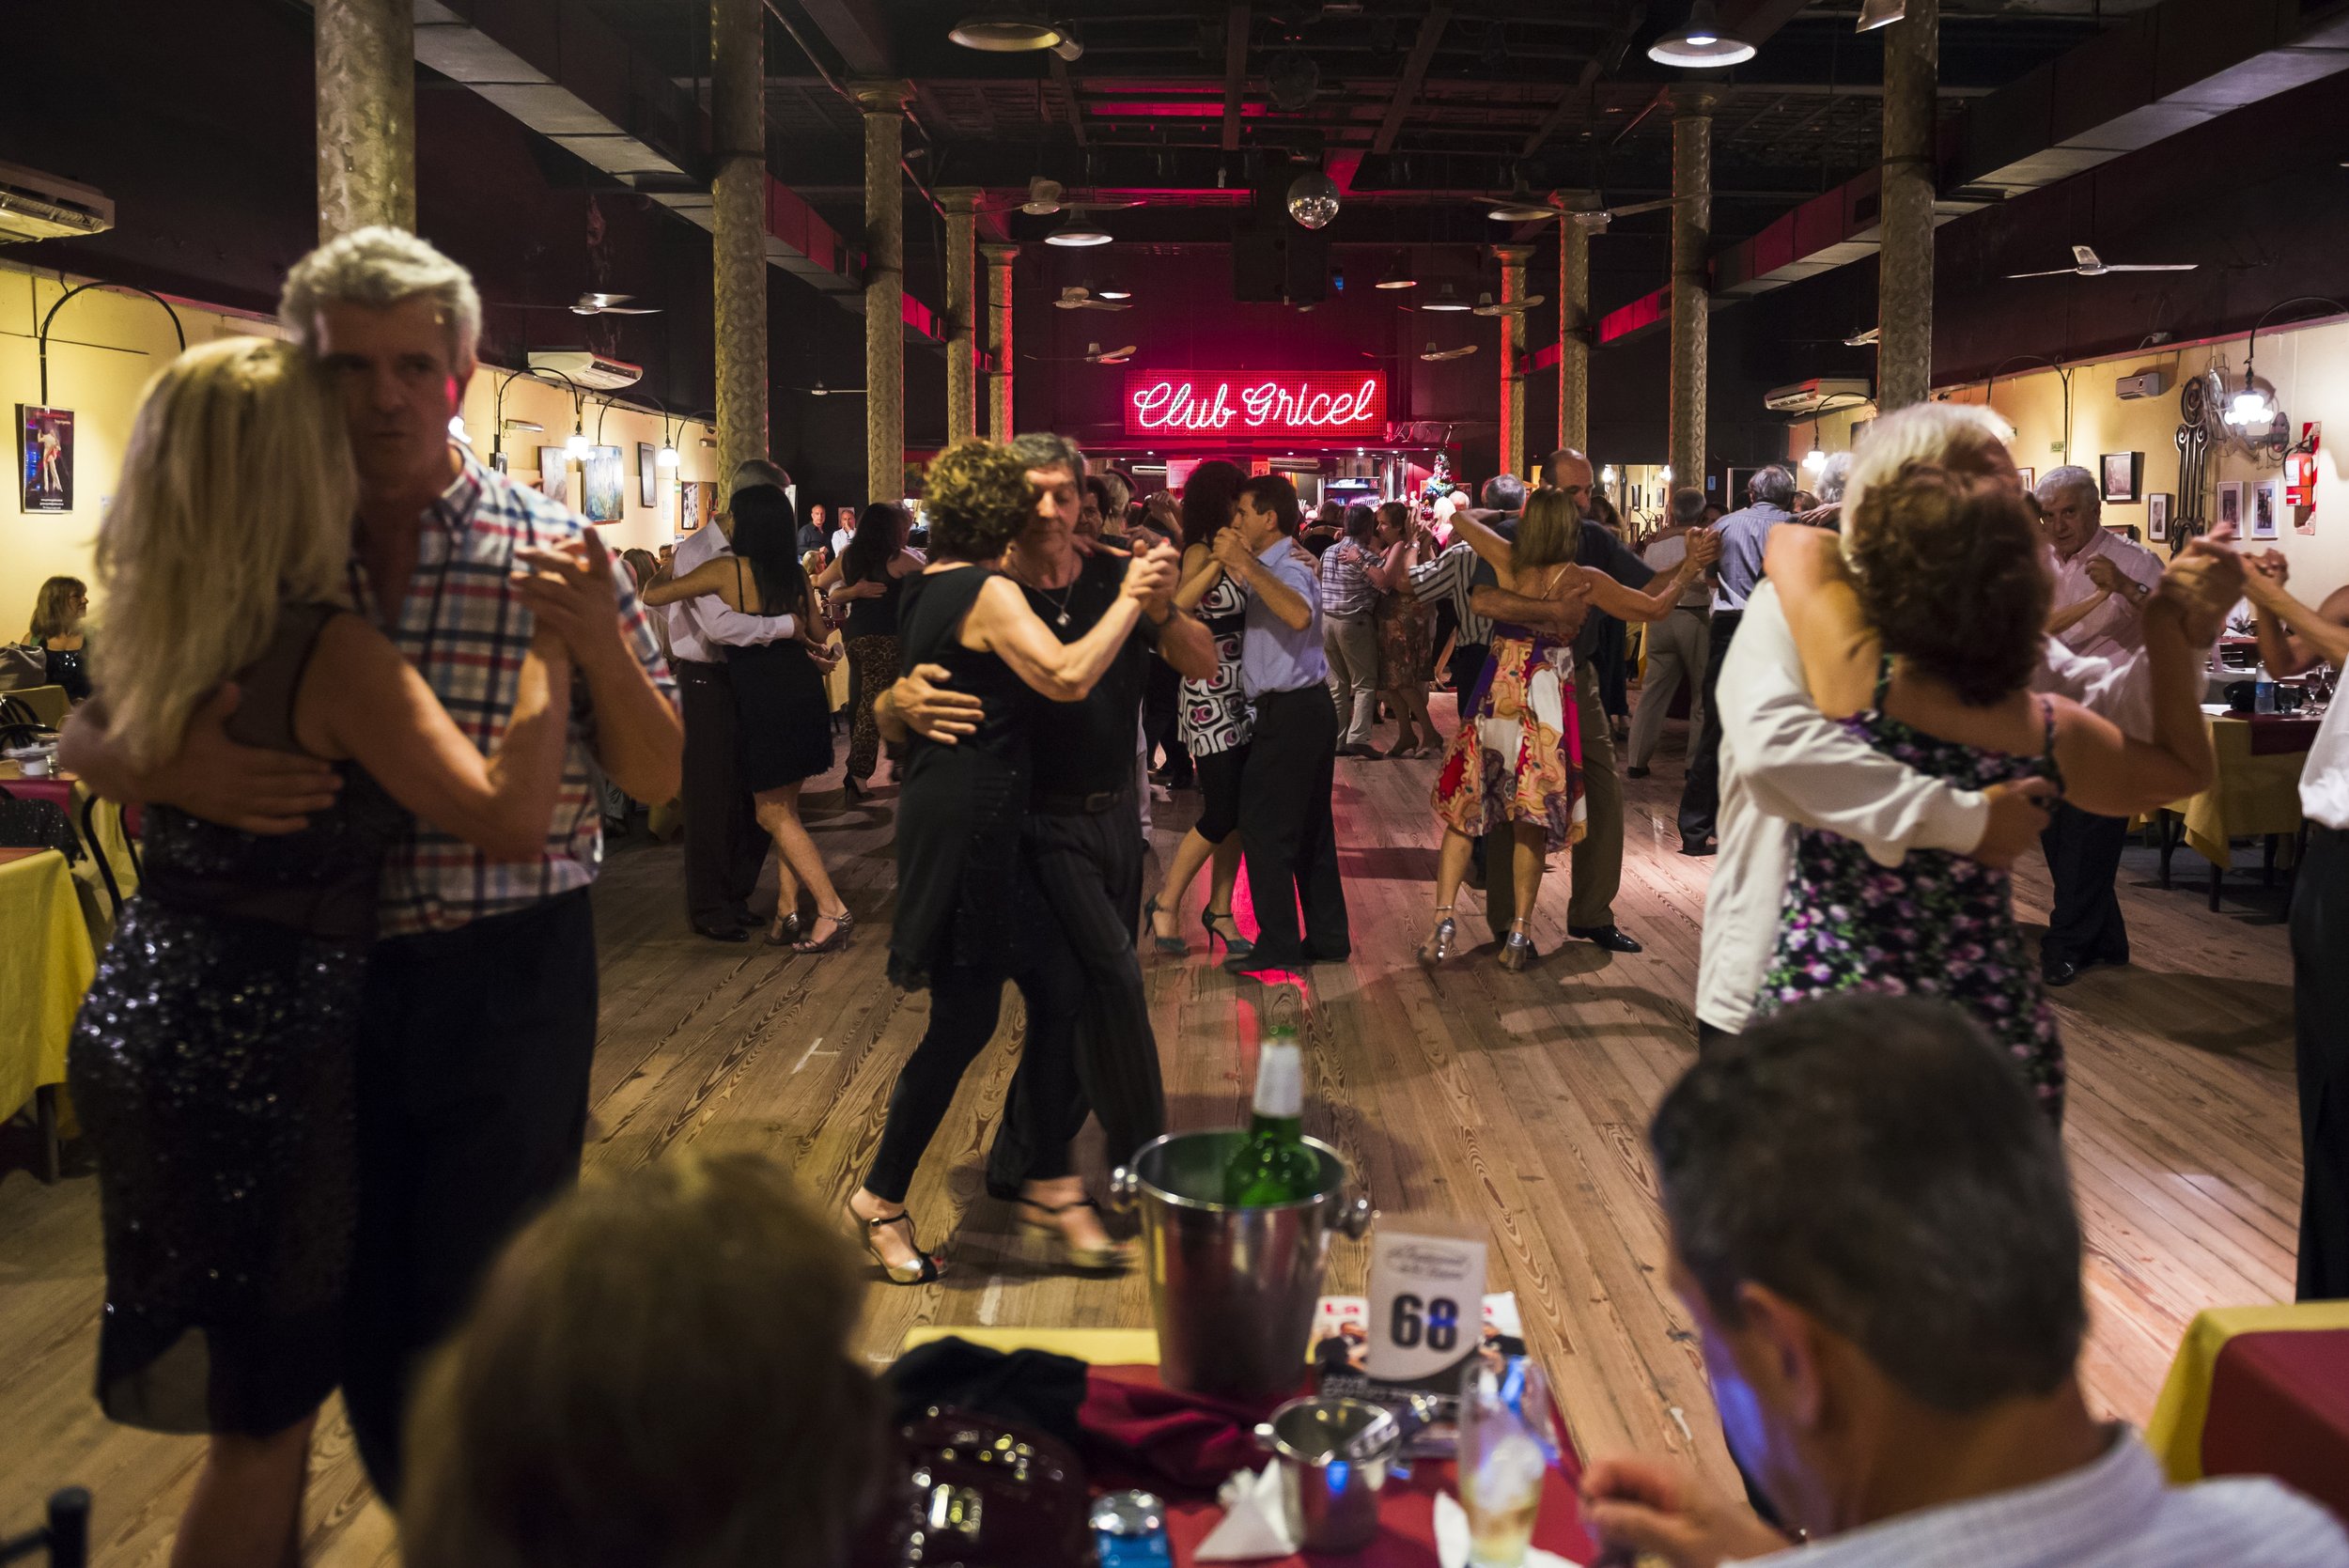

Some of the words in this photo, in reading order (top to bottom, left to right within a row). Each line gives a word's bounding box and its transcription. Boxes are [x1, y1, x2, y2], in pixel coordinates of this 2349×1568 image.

[1133, 382, 1237, 428] Club
[1242, 380, 1375, 426] Gricel
[1392, 1295, 1458, 1352] 68
